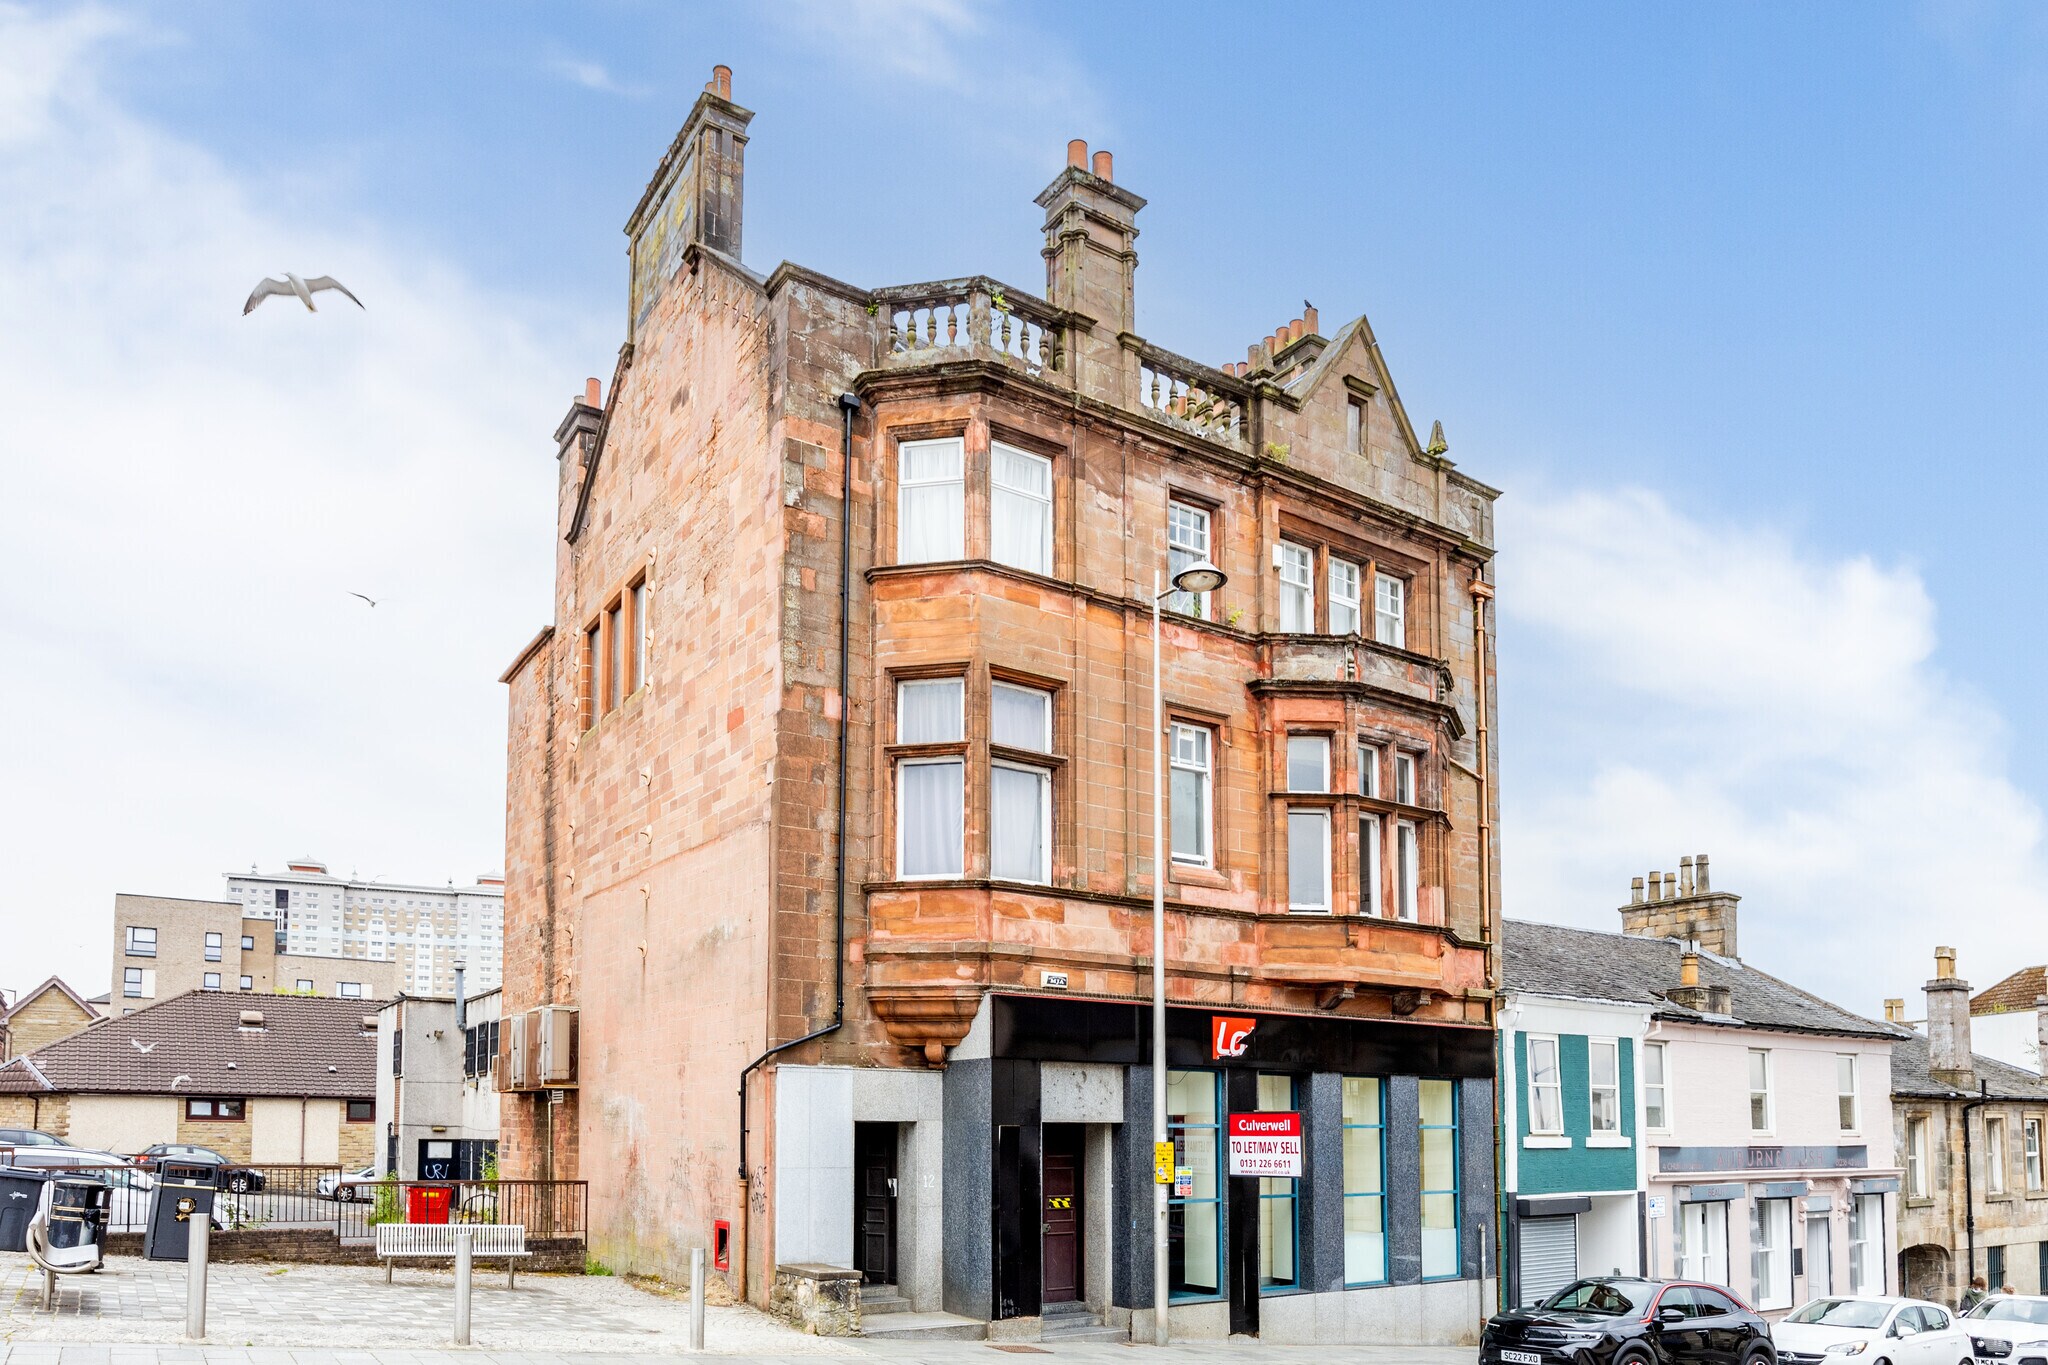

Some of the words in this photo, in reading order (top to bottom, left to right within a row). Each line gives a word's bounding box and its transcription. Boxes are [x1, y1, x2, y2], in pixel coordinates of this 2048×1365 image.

[1238, 1119, 1291, 1131] Culverwell
[1232, 1141, 1241, 1154] TO
[1280, 1141, 1299, 1154] SELL
[1240, 1159, 1257, 1168] 0131
[1259, 1159, 1272, 1168] 226
[1273, 1159, 1291, 1168] 6611
[923, 1174, 935, 1188] 12
[1504, 1351, 1522, 1361] SC22
